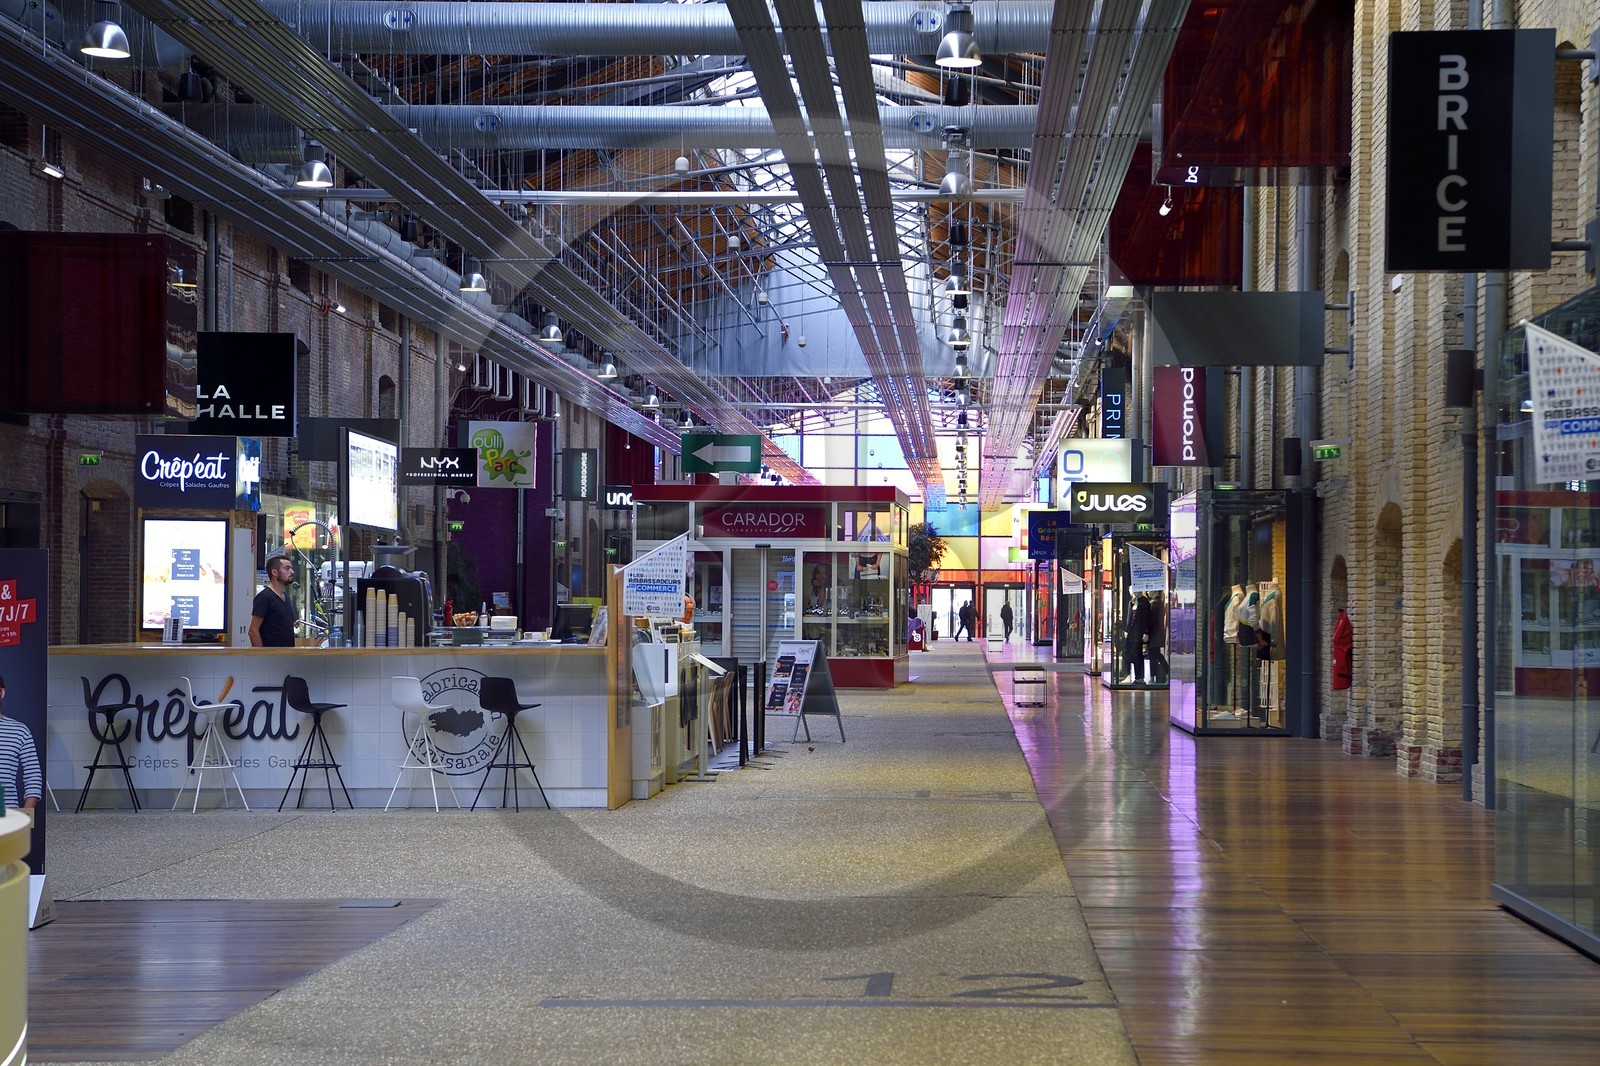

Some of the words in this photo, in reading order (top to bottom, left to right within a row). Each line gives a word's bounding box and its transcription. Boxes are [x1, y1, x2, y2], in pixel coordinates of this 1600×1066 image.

[1436, 54, 1470, 252] BRICE
[196, 384, 231, 399] LA
[196, 403, 286, 420] HALLE
[1180, 367, 1196, 461] promod
[1543, 407, 1600, 420] AMBASS
[473, 435, 502, 449] oulli
[420, 456, 459, 470] NYX
[485, 448, 518, 473] Parc
[140, 450, 231, 492] Crêp'eat
[185, 481, 207, 489] Salades
[208, 481, 230, 489] Gaufres
[721, 512, 806, 527] CARADOR
[628, 577, 682, 585] AMBASSADEURS
[1, 584, 12, 600] &
[0, 603, 29, 623] 7J/7
[127, 755, 179, 772] Crêpes
[204, 755, 260, 769] Salades
